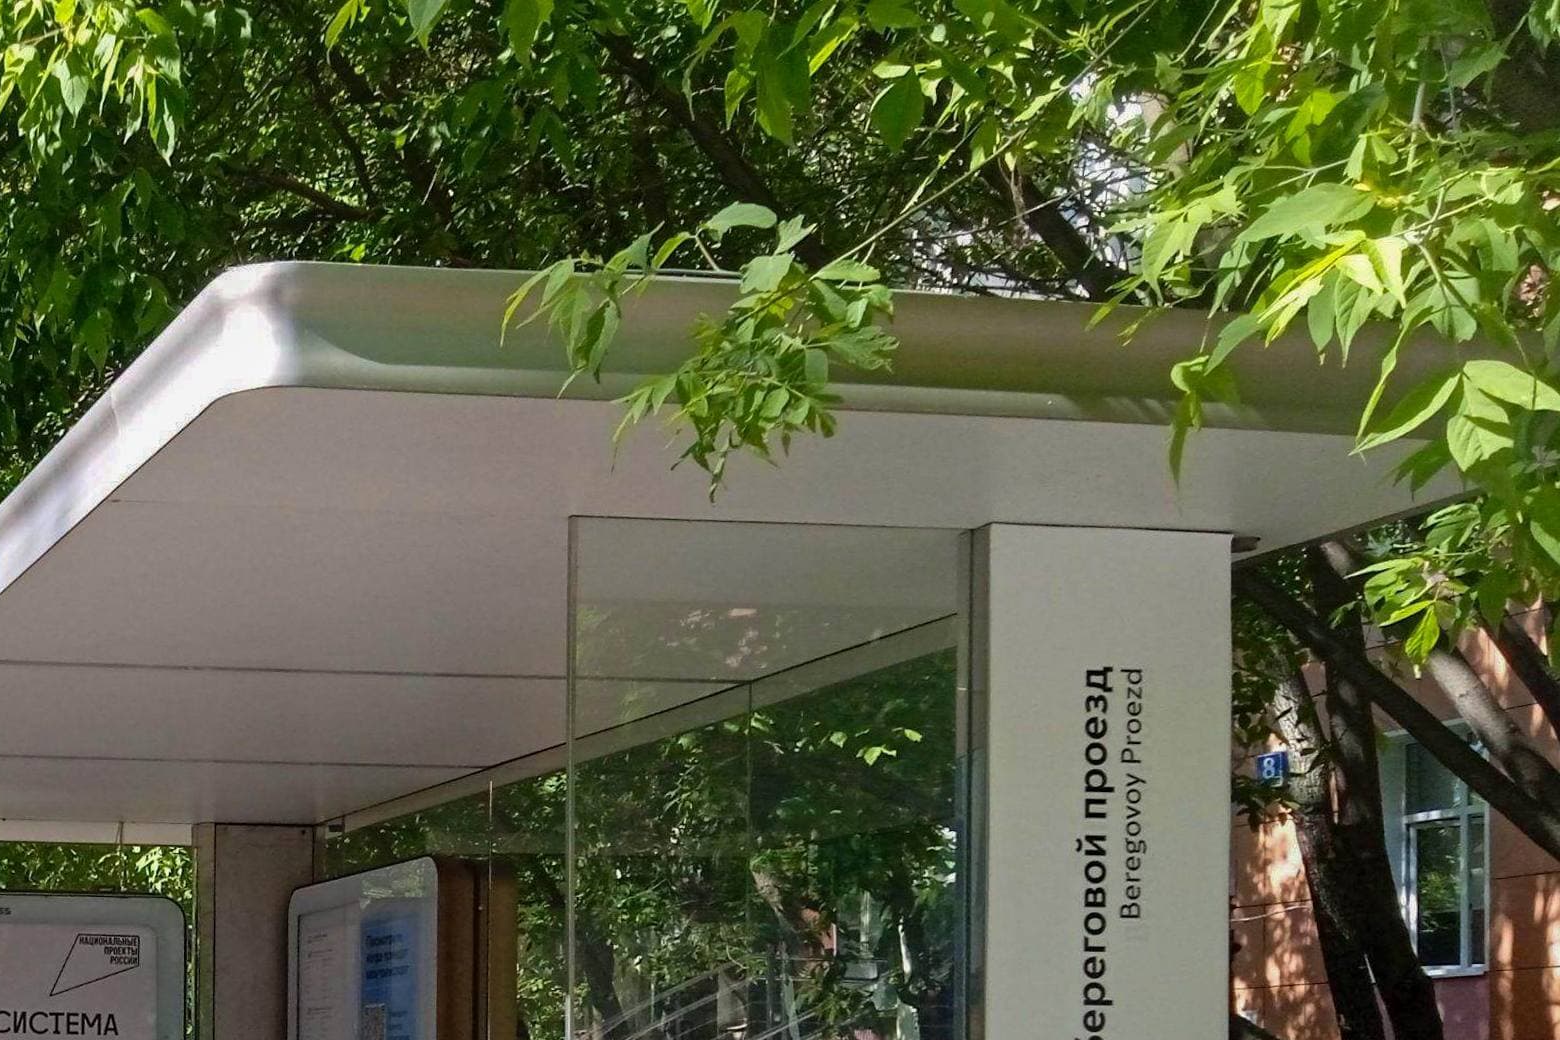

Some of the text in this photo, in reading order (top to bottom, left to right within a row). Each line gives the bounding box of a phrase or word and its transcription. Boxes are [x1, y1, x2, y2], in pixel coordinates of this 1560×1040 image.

[1083, 665, 1115, 819] проезд
[1262, 757, 1275, 779] 8
[1120, 668, 1146, 919] Beregovoy Proezd
[79, 936, 137, 947] НАЦИОНАЛЬНЫЕ
[103, 946, 138, 956] ПРОЕКТЫ
[109, 955, 138, 965] РОССИИ
